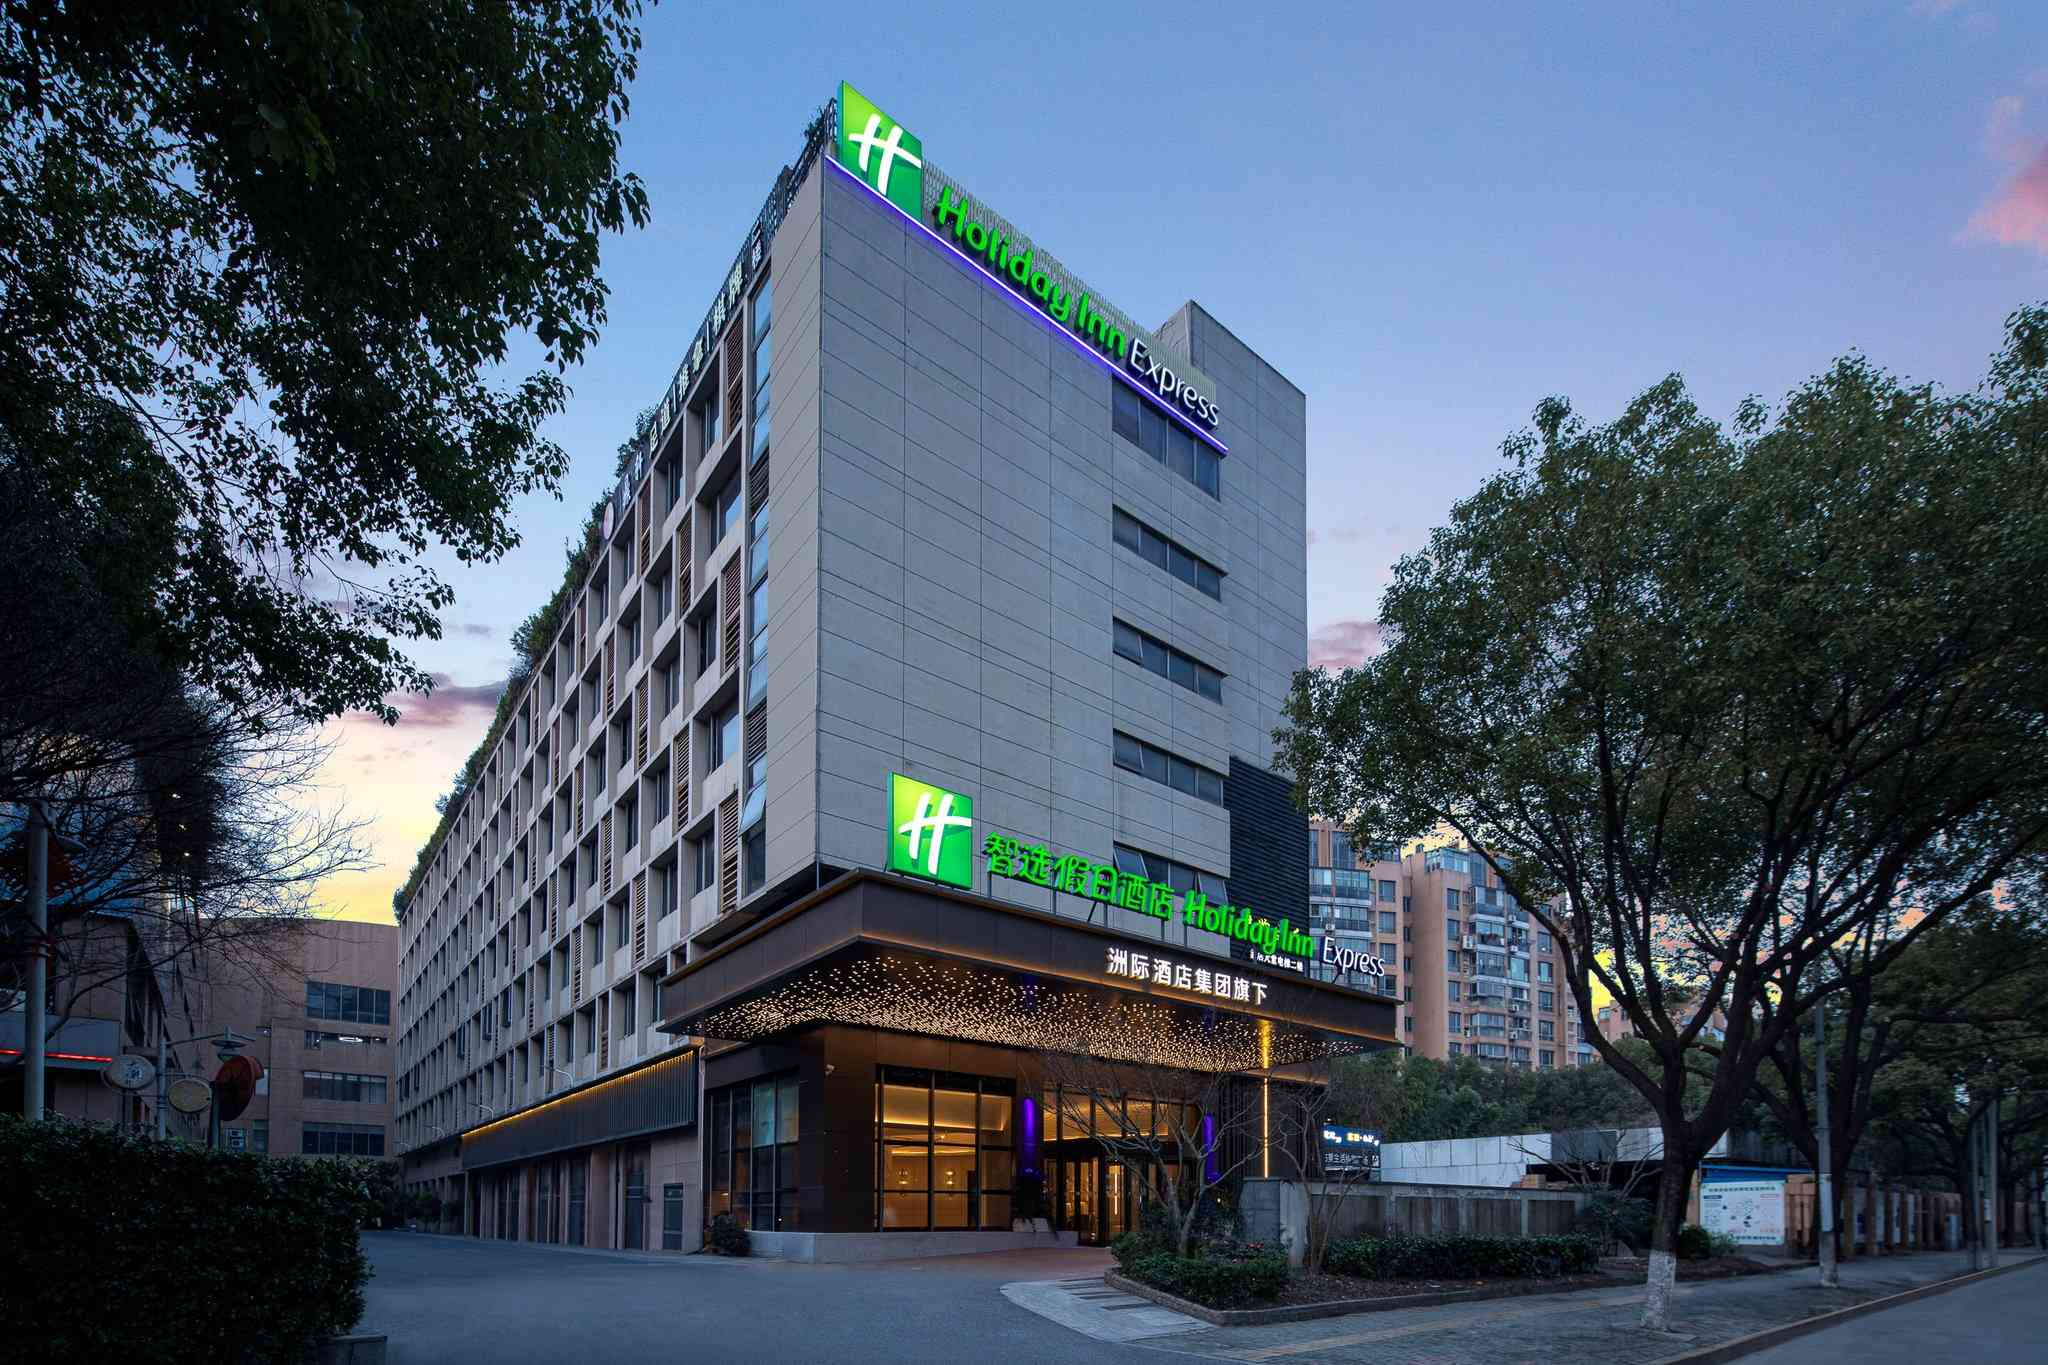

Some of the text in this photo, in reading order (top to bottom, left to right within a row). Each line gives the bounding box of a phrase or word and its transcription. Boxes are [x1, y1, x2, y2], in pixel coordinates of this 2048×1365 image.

[935, 186, 1219, 426] Holiday Inn Express
[984, 831, 1175, 921] 智选假日酒店
[1105, 947, 1268, 1005] 洲际酒店集团旗下
[1184, 890, 1280, 954] Holiday
[1280, 917, 1314, 958] Inn
[1322, 936, 1386, 977] Express
